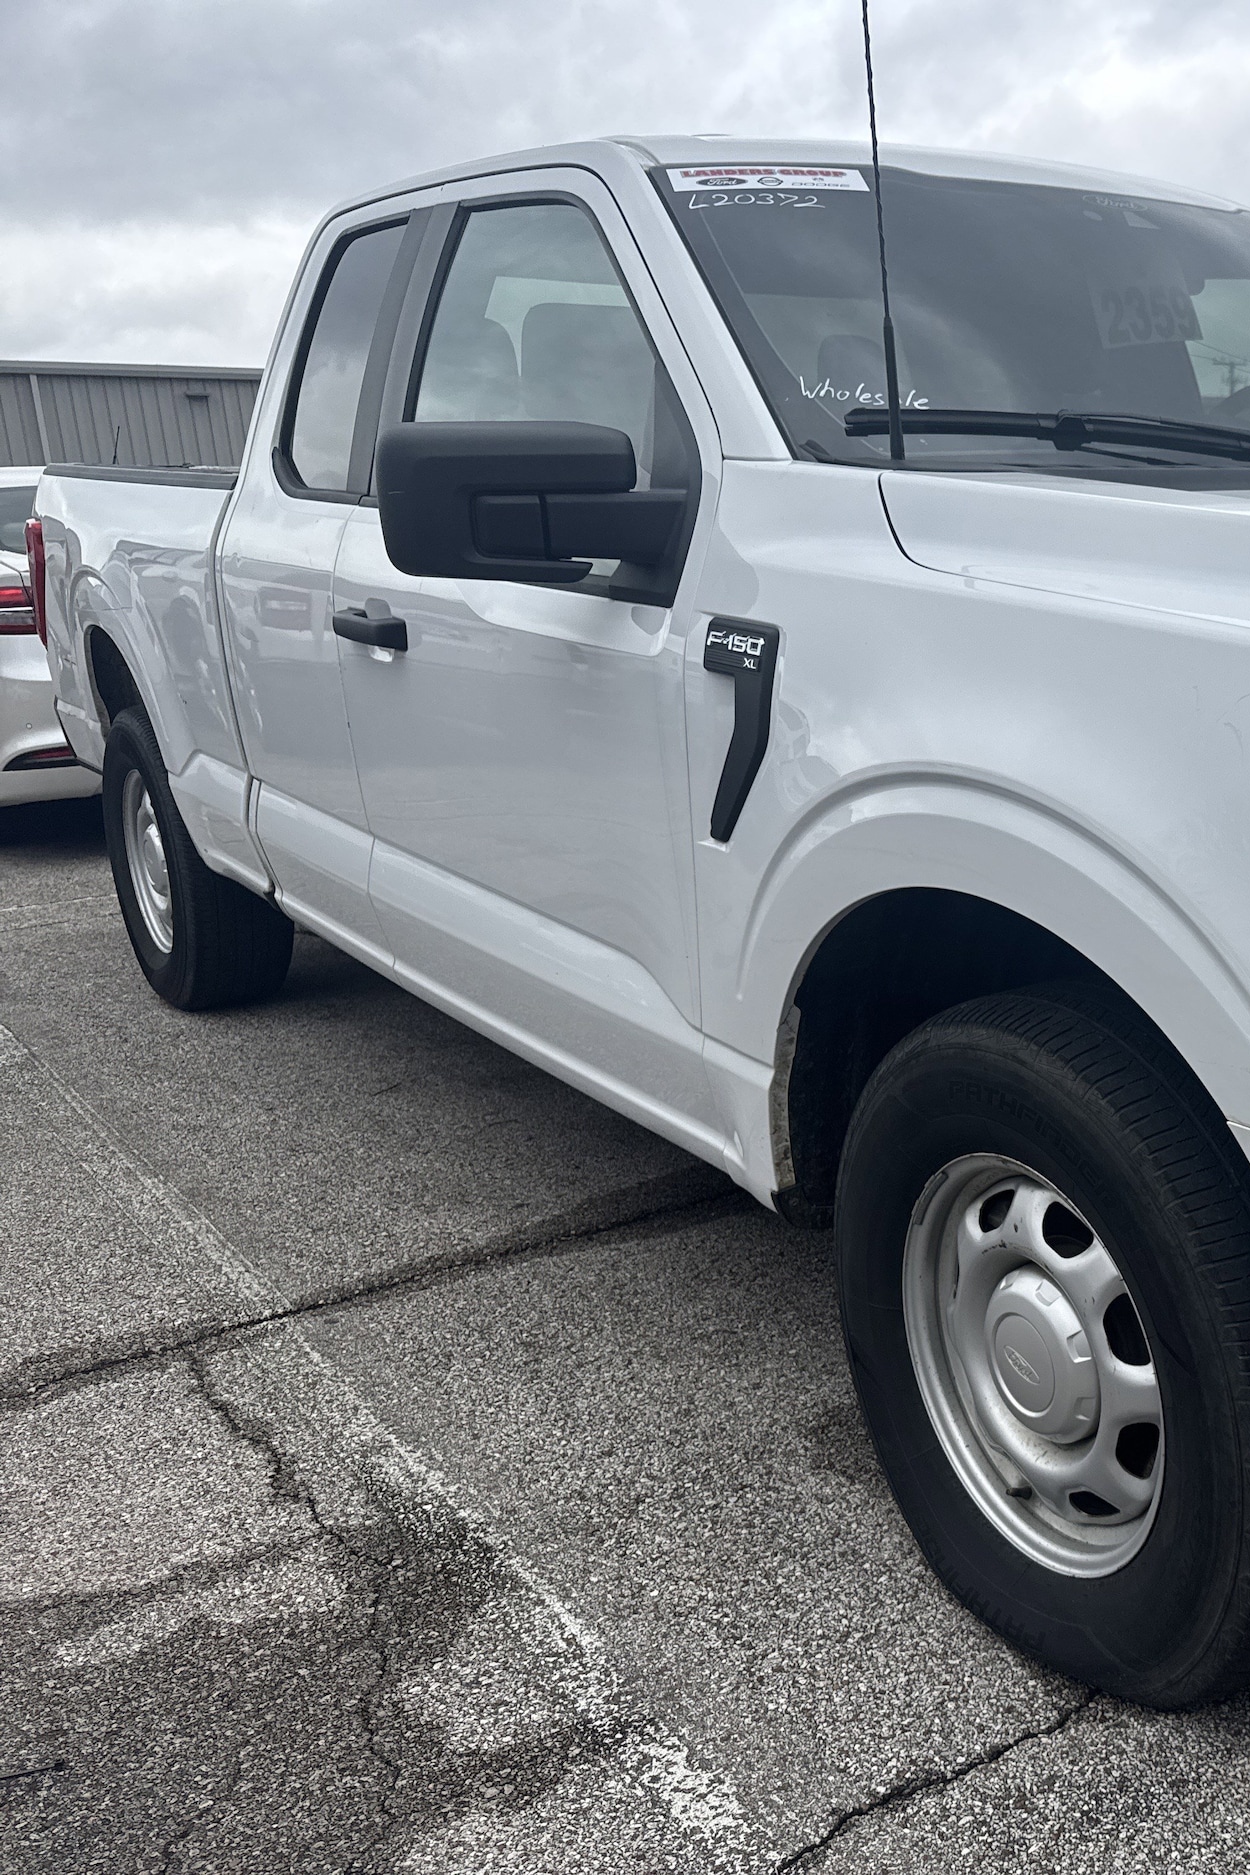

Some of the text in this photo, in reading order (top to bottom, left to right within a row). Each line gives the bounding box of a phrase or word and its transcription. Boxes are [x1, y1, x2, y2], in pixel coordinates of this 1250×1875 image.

[680, 168, 848, 179] LANDERS GROUP
[707, 176, 737, 186] Ford
[688, 193, 826, 210] L20372
[1100, 286, 1197, 345] 2359
[800, 375, 930, 410] Wholesle
[706, 631, 766, 657] F-150
[743, 657, 757, 670] XL
